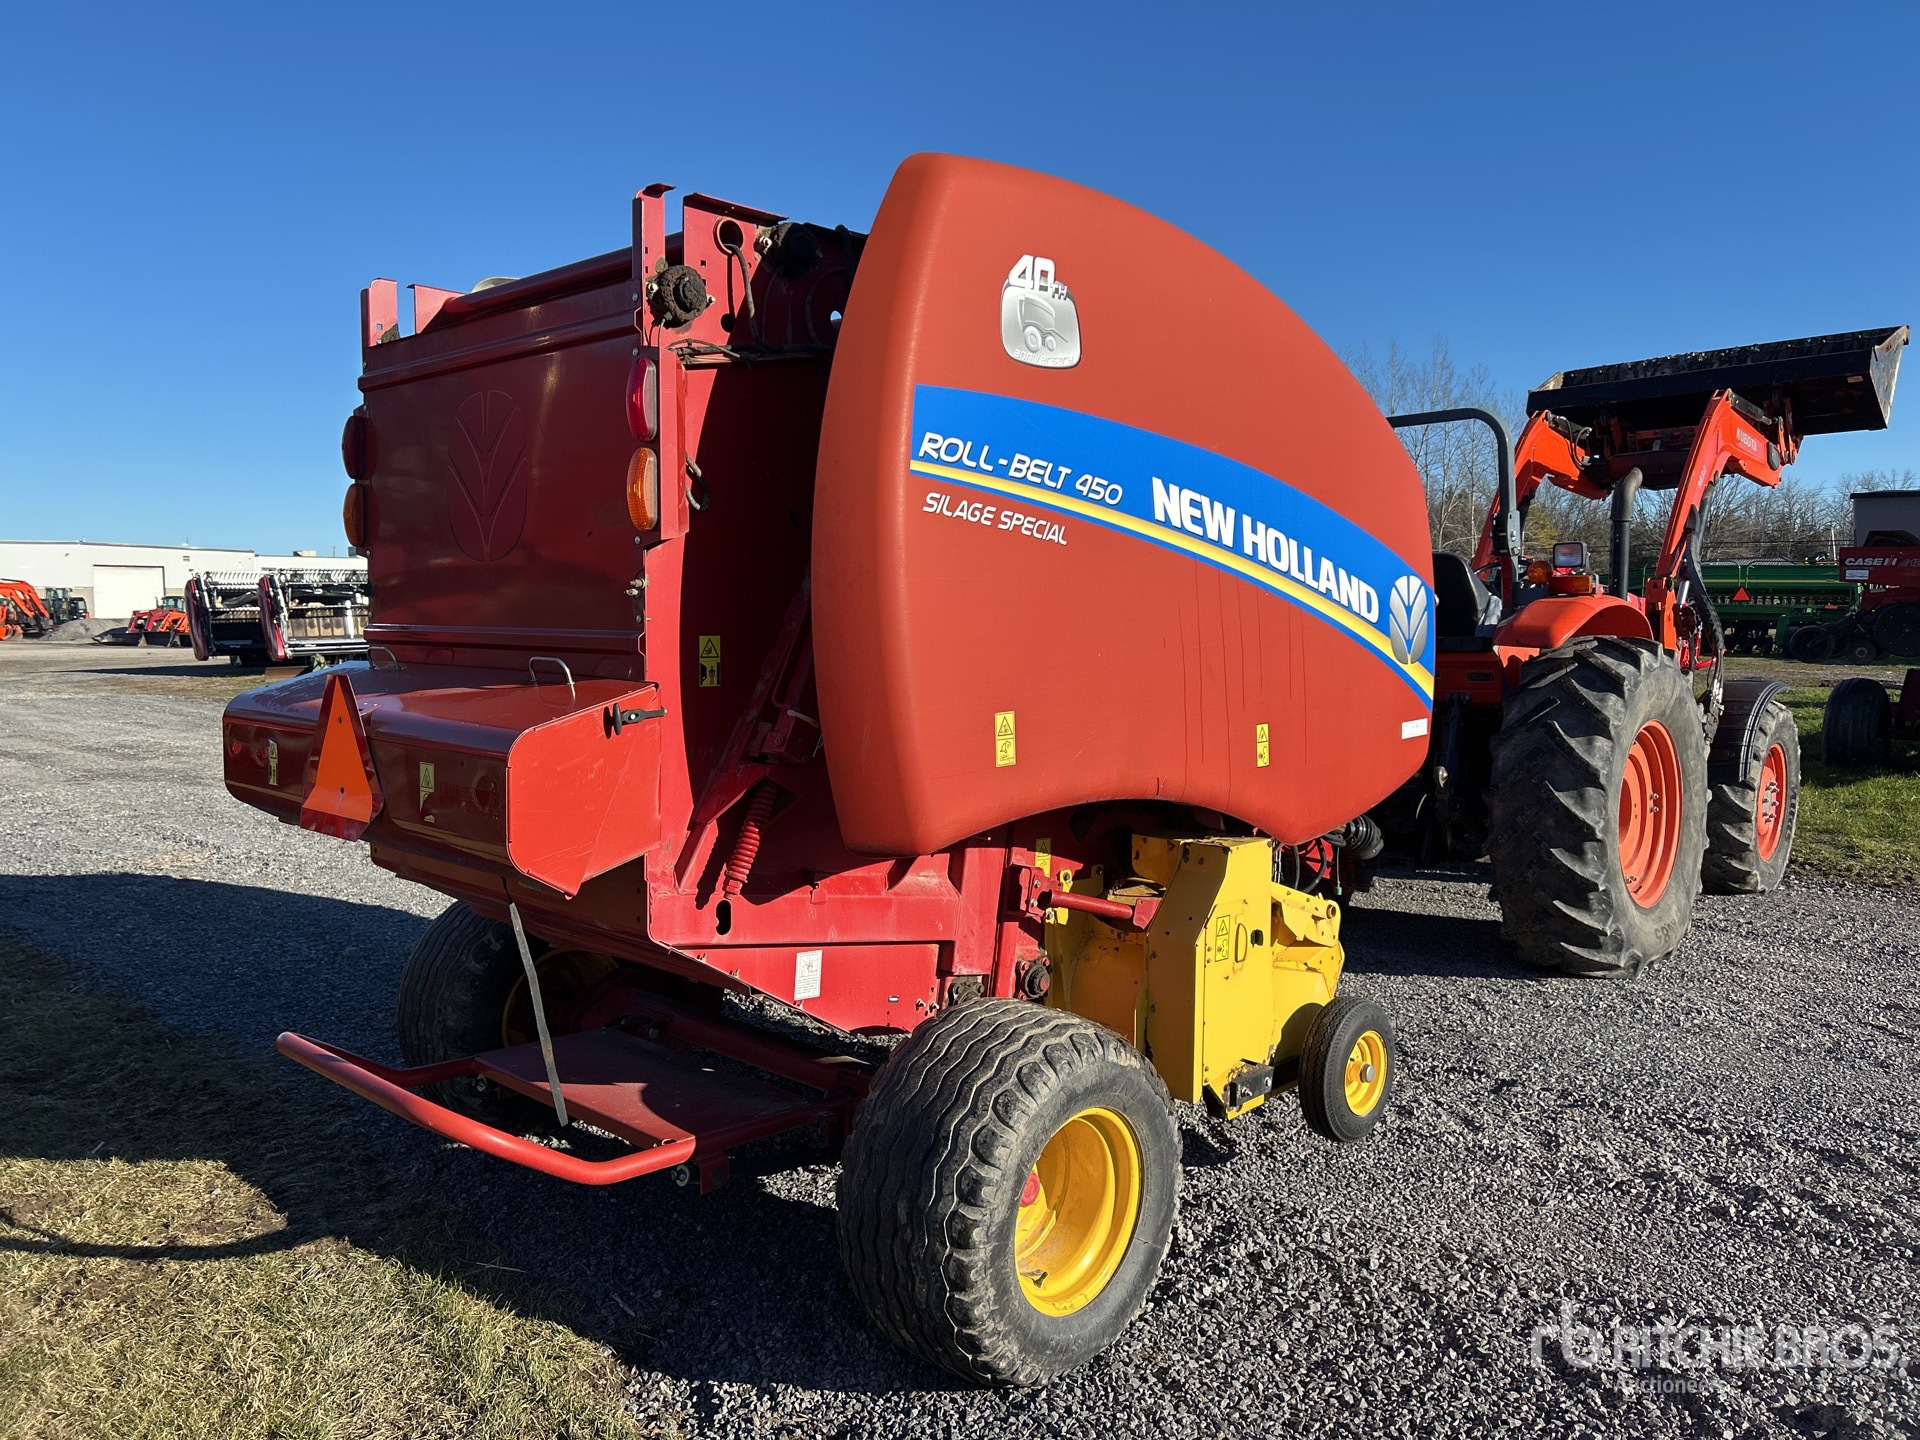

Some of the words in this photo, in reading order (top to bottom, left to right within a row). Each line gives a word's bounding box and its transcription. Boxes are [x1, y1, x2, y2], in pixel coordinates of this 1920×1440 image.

[1736, 427, 1757, 452] KUBOTA
[1075, 473, 1123, 506] 450
[922, 492, 996, 526] SILAGE
[997, 510, 1068, 546] SPECIAL
[1152, 476, 1236, 549] NEW
[1242, 513, 1379, 624] HOLLAND
